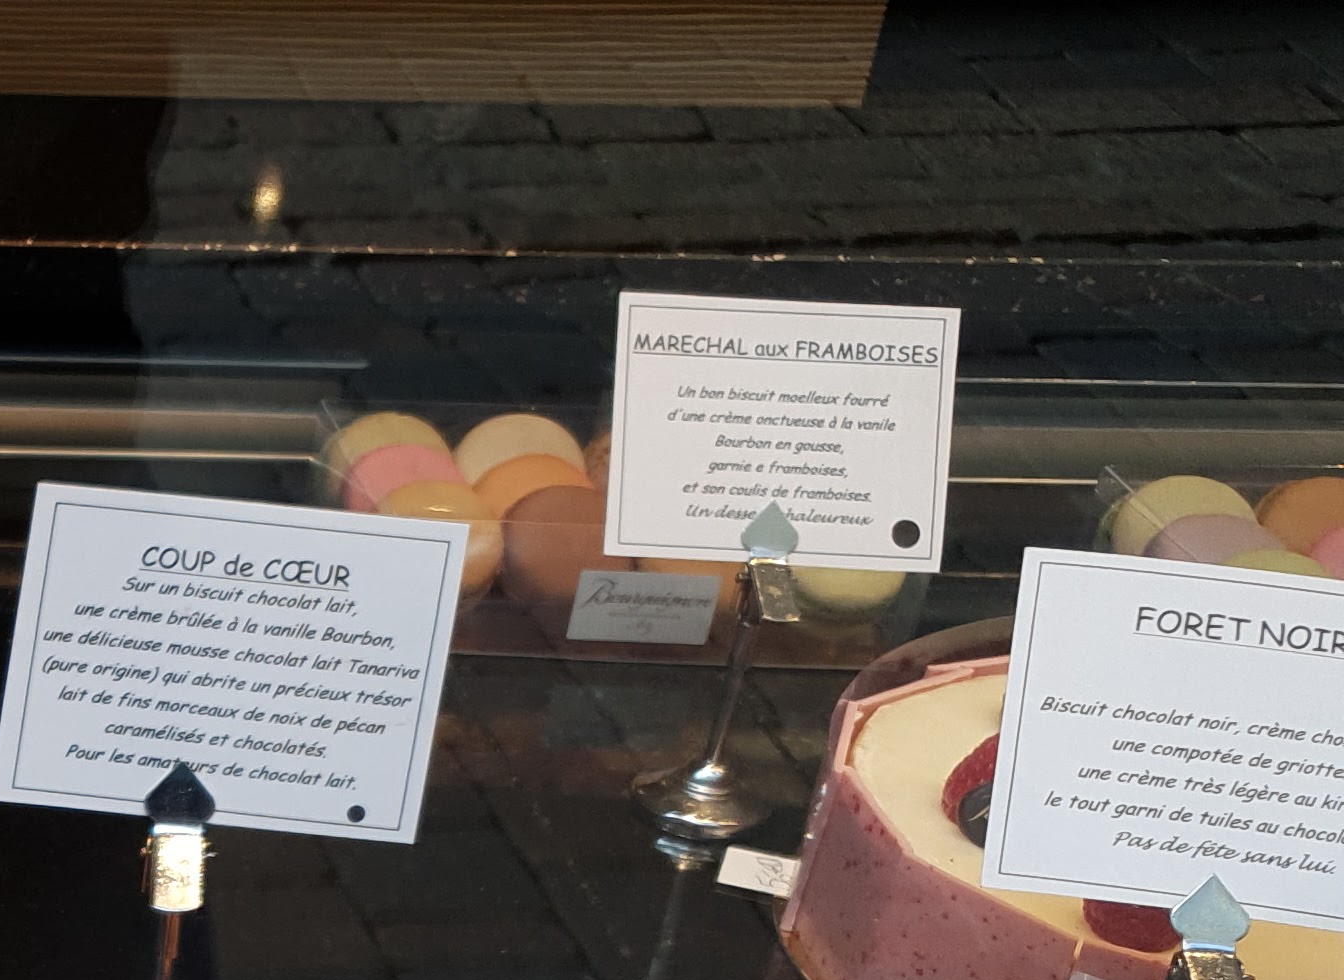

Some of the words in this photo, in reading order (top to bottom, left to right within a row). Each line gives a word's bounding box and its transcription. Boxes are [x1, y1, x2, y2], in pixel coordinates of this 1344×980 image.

[634, 333, 749, 356] MARECHAL
[754, 344, 789, 358] aux
[795, 340, 938, 365] FRAMBOISES
[677, 385, 697, 398] Un
[699, 385, 725, 400] bon
[727, 387, 776, 402] biscuit
[777, 390, 841, 405] moelleux
[842, 392, 892, 408] fourré
[709, 410, 753, 425] crème
[755, 415, 826, 429] onctueuse
[828, 415, 838, 429] à
[840, 416, 854, 430] la
[857, 417, 897, 432] vanile
[714, 434, 772, 450] Bourbon
[774, 440, 792, 450] en
[793, 441, 845, 455] gousse,
[706, 460, 753, 475] garnie
[755, 463, 765, 473] e
[768, 460, 849, 479] framboises,
[682, 482, 699, 494] et
[700, 484, 726, 495] son
[729, 483, 769, 498] coulis
[771, 484, 790, 499] de
[792, 485, 872, 503] framboises.
[141, 546, 217, 573] COUP
[223, 553, 254, 578] de
[263, 558, 350, 588] CŒUR
[121, 576, 156, 593] Sur
[158, 584, 180, 596] un
[182, 582, 244, 603] biscuit
[246, 589, 322, 611] chocolat
[324, 596, 357, 618] lait,
[74, 604, 105, 618] une
[108, 605, 164, 623] crème
[165, 610, 224, 630] brûlée
[226, 616, 239, 632] à
[241, 617, 259, 634] la
[263, 622, 318, 640] vanille
[320, 626, 395, 651] Bourbon,
[1135, 606, 1252, 642] FORET
[43, 630, 74, 643] une
[77, 630, 163, 653] délicieuse
[165, 642, 230, 660] mousse
[234, 647, 309, 668] chocolat
[311, 654, 343, 672] lait
[349, 658, 421, 680] Tanariva
[42, 655, 89, 675] (pure
[92, 662, 160, 684] origine)
[161, 670, 191, 687] qui
[191, 672, 247, 691] abrite
[249, 682, 272, 694] un
[272, 682, 352, 702] précieux
[355, 690, 412, 708] trésor
[57, 685, 89, 702] lait
[91, 689, 114, 705] de
[117, 691, 153, 709] fins
[154, 700, 241, 719] morceaux
[242, 706, 266, 722] de
[268, 711, 308, 727] noix
[310, 713, 333, 729] de
[332, 716, 386, 735] pécan
[1039, 696, 1109, 717] Biscuit
[1111, 703, 1195, 727] chocolat
[1197, 716, 1240, 736] noir,
[1246, 721, 1307, 741] crème
[1310, 729, 1344, 746] cho
[104, 723, 206, 744] caramélisés
[208, 733, 230, 747] et
[232, 734, 327, 759] chocolatés.
[1112, 739, 1147, 753] une
[1150, 744, 1244, 765] compotée
[1248, 752, 1273, 769] de
[64, 743, 106, 761] Pour
[109, 747, 136, 765] les
[136, 756, 220, 775] amaturs
[221, 762, 245, 778] de
[248, 765, 322, 785] chocolat
[324, 772, 356, 791] lait.
[1077, 767, 1112, 781] une
[1116, 769, 1178, 789] crème
[1183, 776, 1226, 795] très
[1228, 780, 1291, 804] légère
[1293, 795, 1318, 808] au
[1043, 790, 1063, 807] le
[1068, 795, 1111, 813] tout
[1110, 803, 1167, 819] garni
[1168, 806, 1194, 823] de
[1199, 811, 1254, 831] tuiles
[1255, 822, 1281, 835] au
[1112, 831, 1159, 851] Pas
[1158, 835, 1194, 854] de
[1240, 850, 1298, 869] sans
[1298, 853, 1336, 875] lui.
